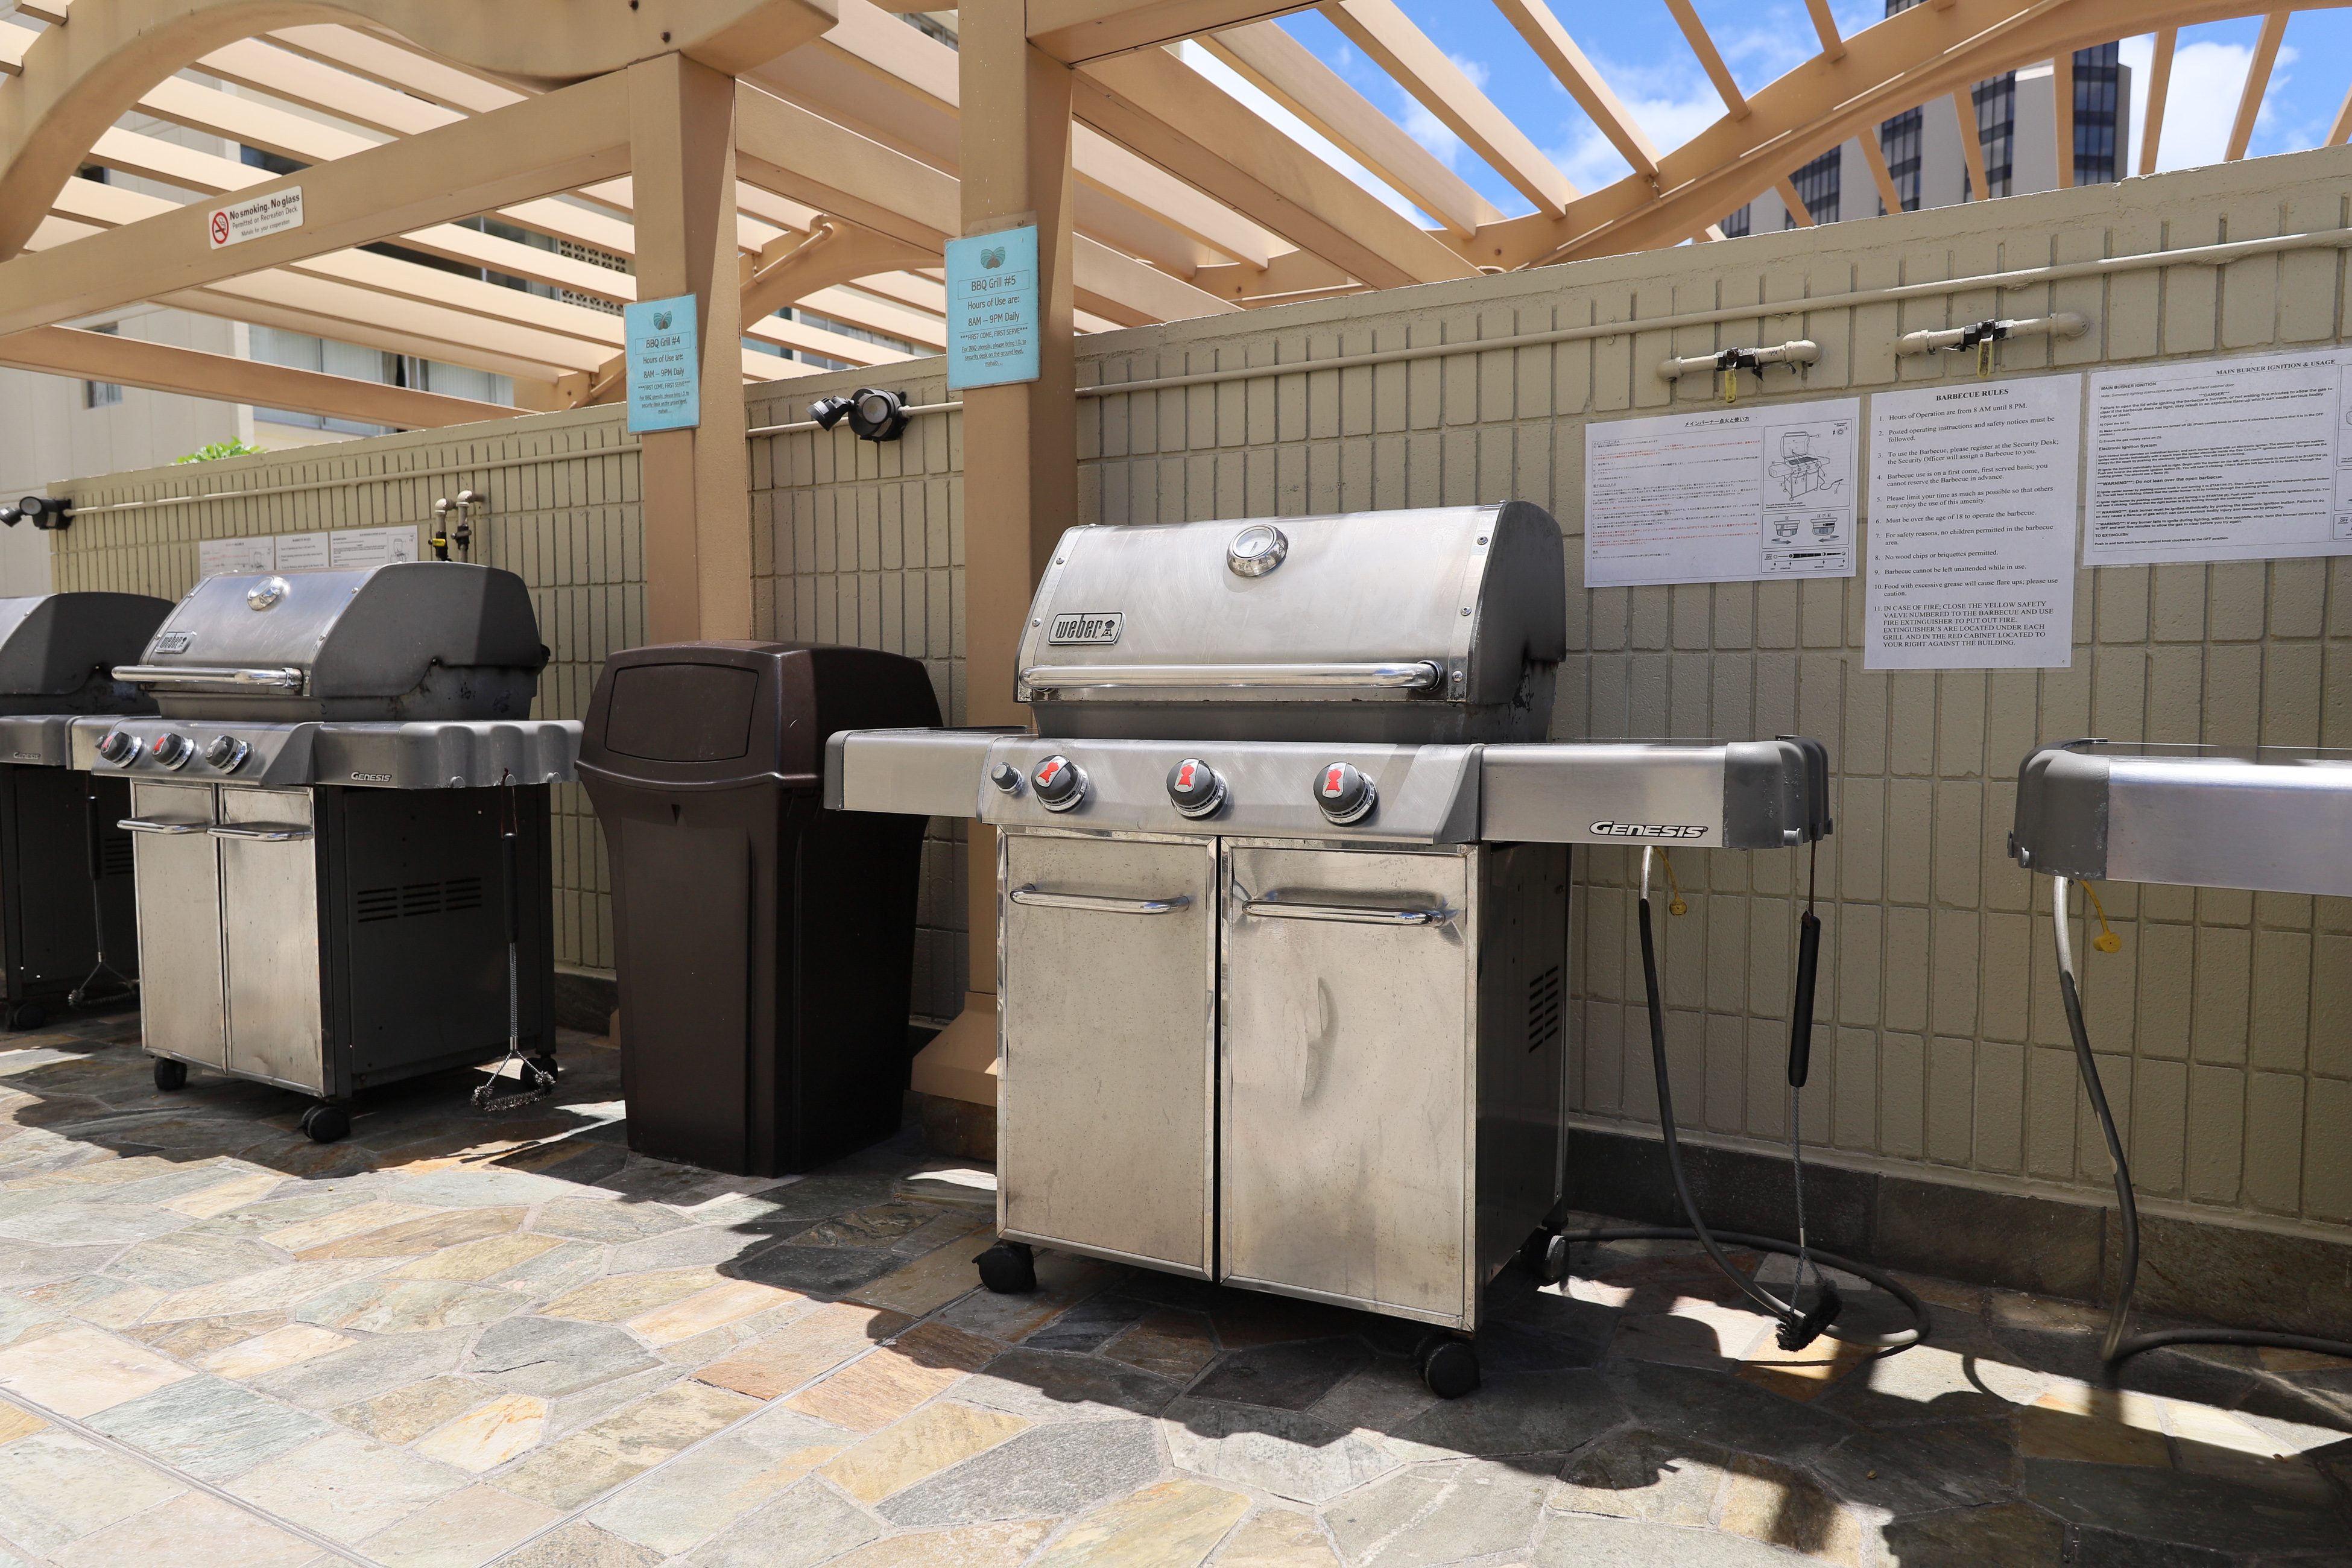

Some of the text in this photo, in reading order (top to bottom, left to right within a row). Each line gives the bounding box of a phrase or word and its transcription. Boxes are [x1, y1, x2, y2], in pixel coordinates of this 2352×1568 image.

[230, 194, 300, 221] No smoking. No glass
[232, 218, 253, 229] Permitted
[261, 210, 284, 221] Recreation
[285, 206, 298, 215] Deck.
[989, 277, 1002, 289] Grill
[1004, 274, 1016, 286] #5
[968, 301, 986, 310] Hours
[987, 297, 994, 308] of
[994, 297, 1007, 306] Use
[968, 317, 981, 327] 8AM
[990, 314, 1003, 324] 9PM
[1005, 311, 1020, 323] Daily
[646, 335, 680, 350] BBQ Grill #4
[659, 354, 665, 363] of
[665, 354, 674, 362] Use
[643, 370, 655, 379] 8AM
[660, 368, 672, 378] 9PM
[673, 367, 684, 377] Daily
[1936, 388, 2009, 401] BARBECUE RULES
[1909, 426, 1936, 435] operating
[1055, 615, 1103, 638] weber
[351, 772, 391, 782] GENESIS
[1589, 821, 1705, 838] GENESIS
